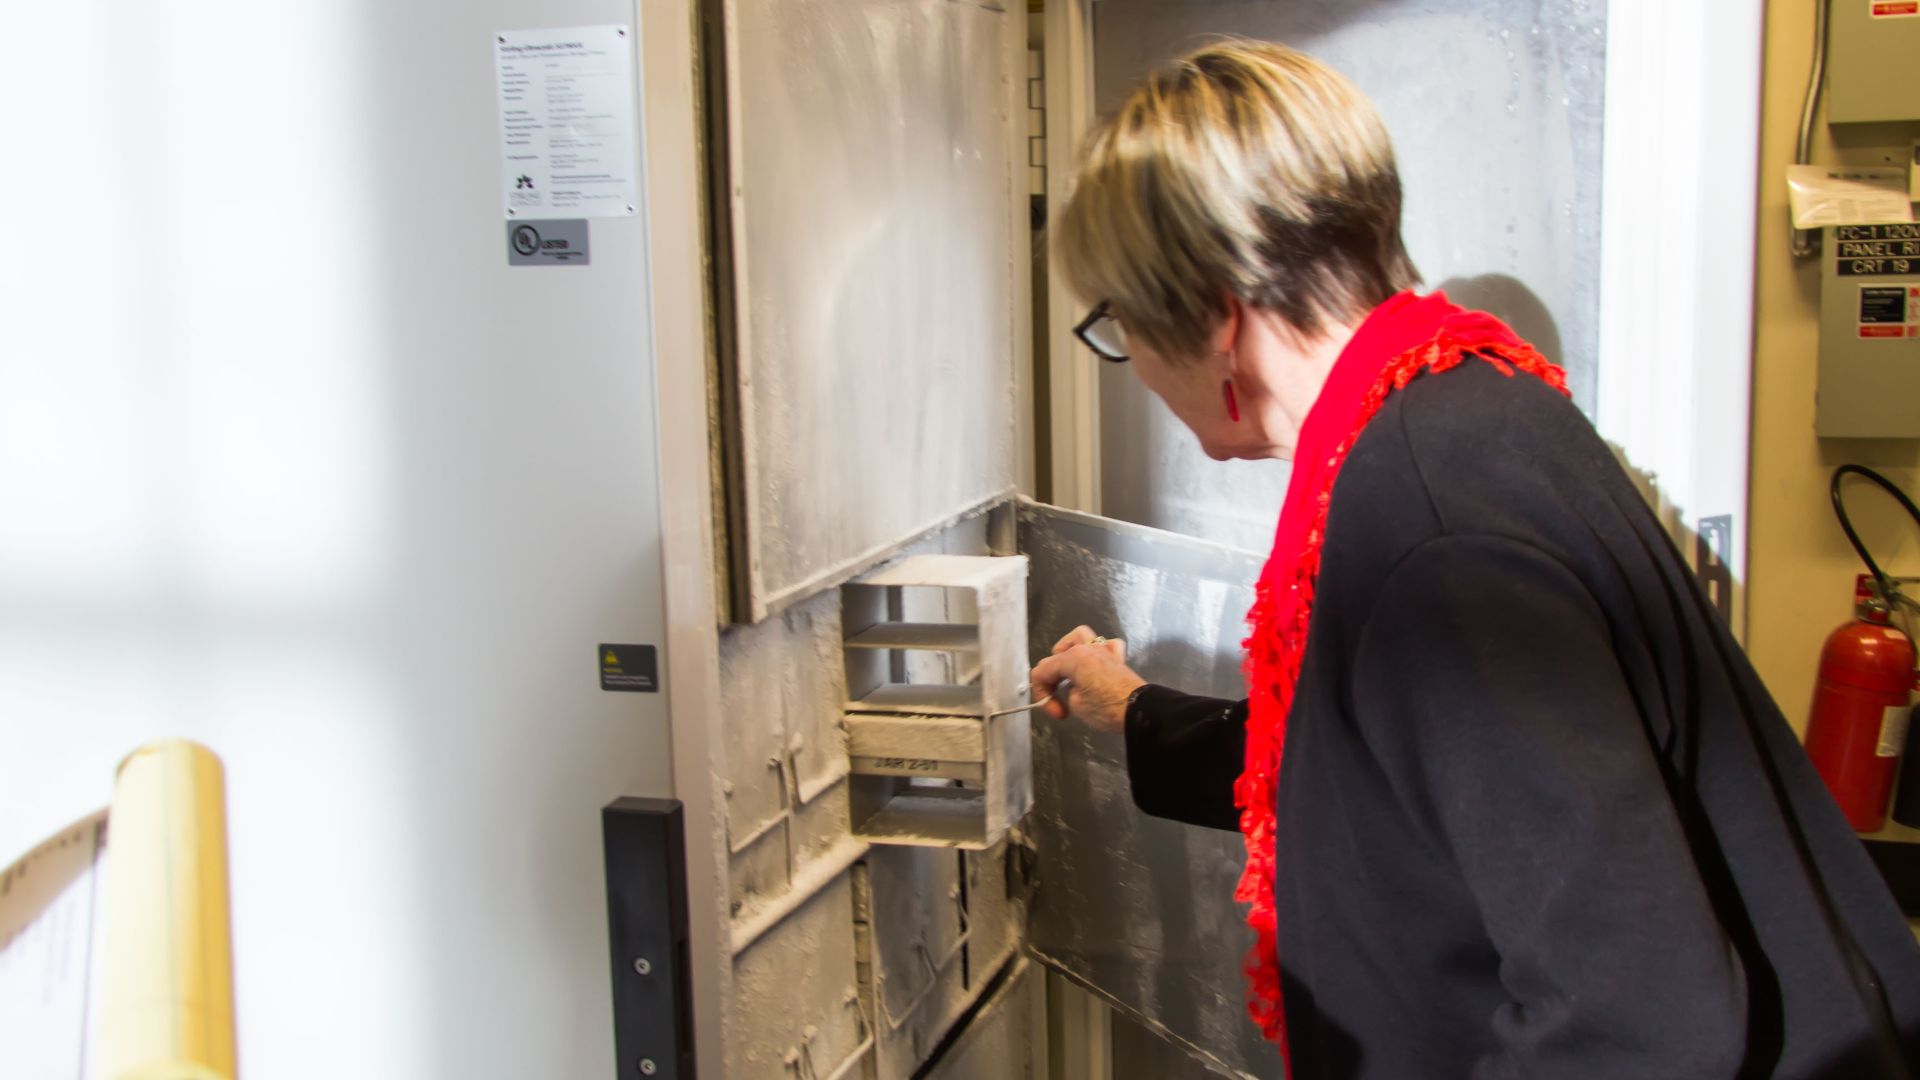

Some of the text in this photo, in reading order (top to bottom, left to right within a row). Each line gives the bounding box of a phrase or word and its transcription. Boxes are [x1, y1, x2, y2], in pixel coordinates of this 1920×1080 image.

[1843, 241, 1897, 256] PANEL
[1852, 258, 1910, 273] CRT 19
